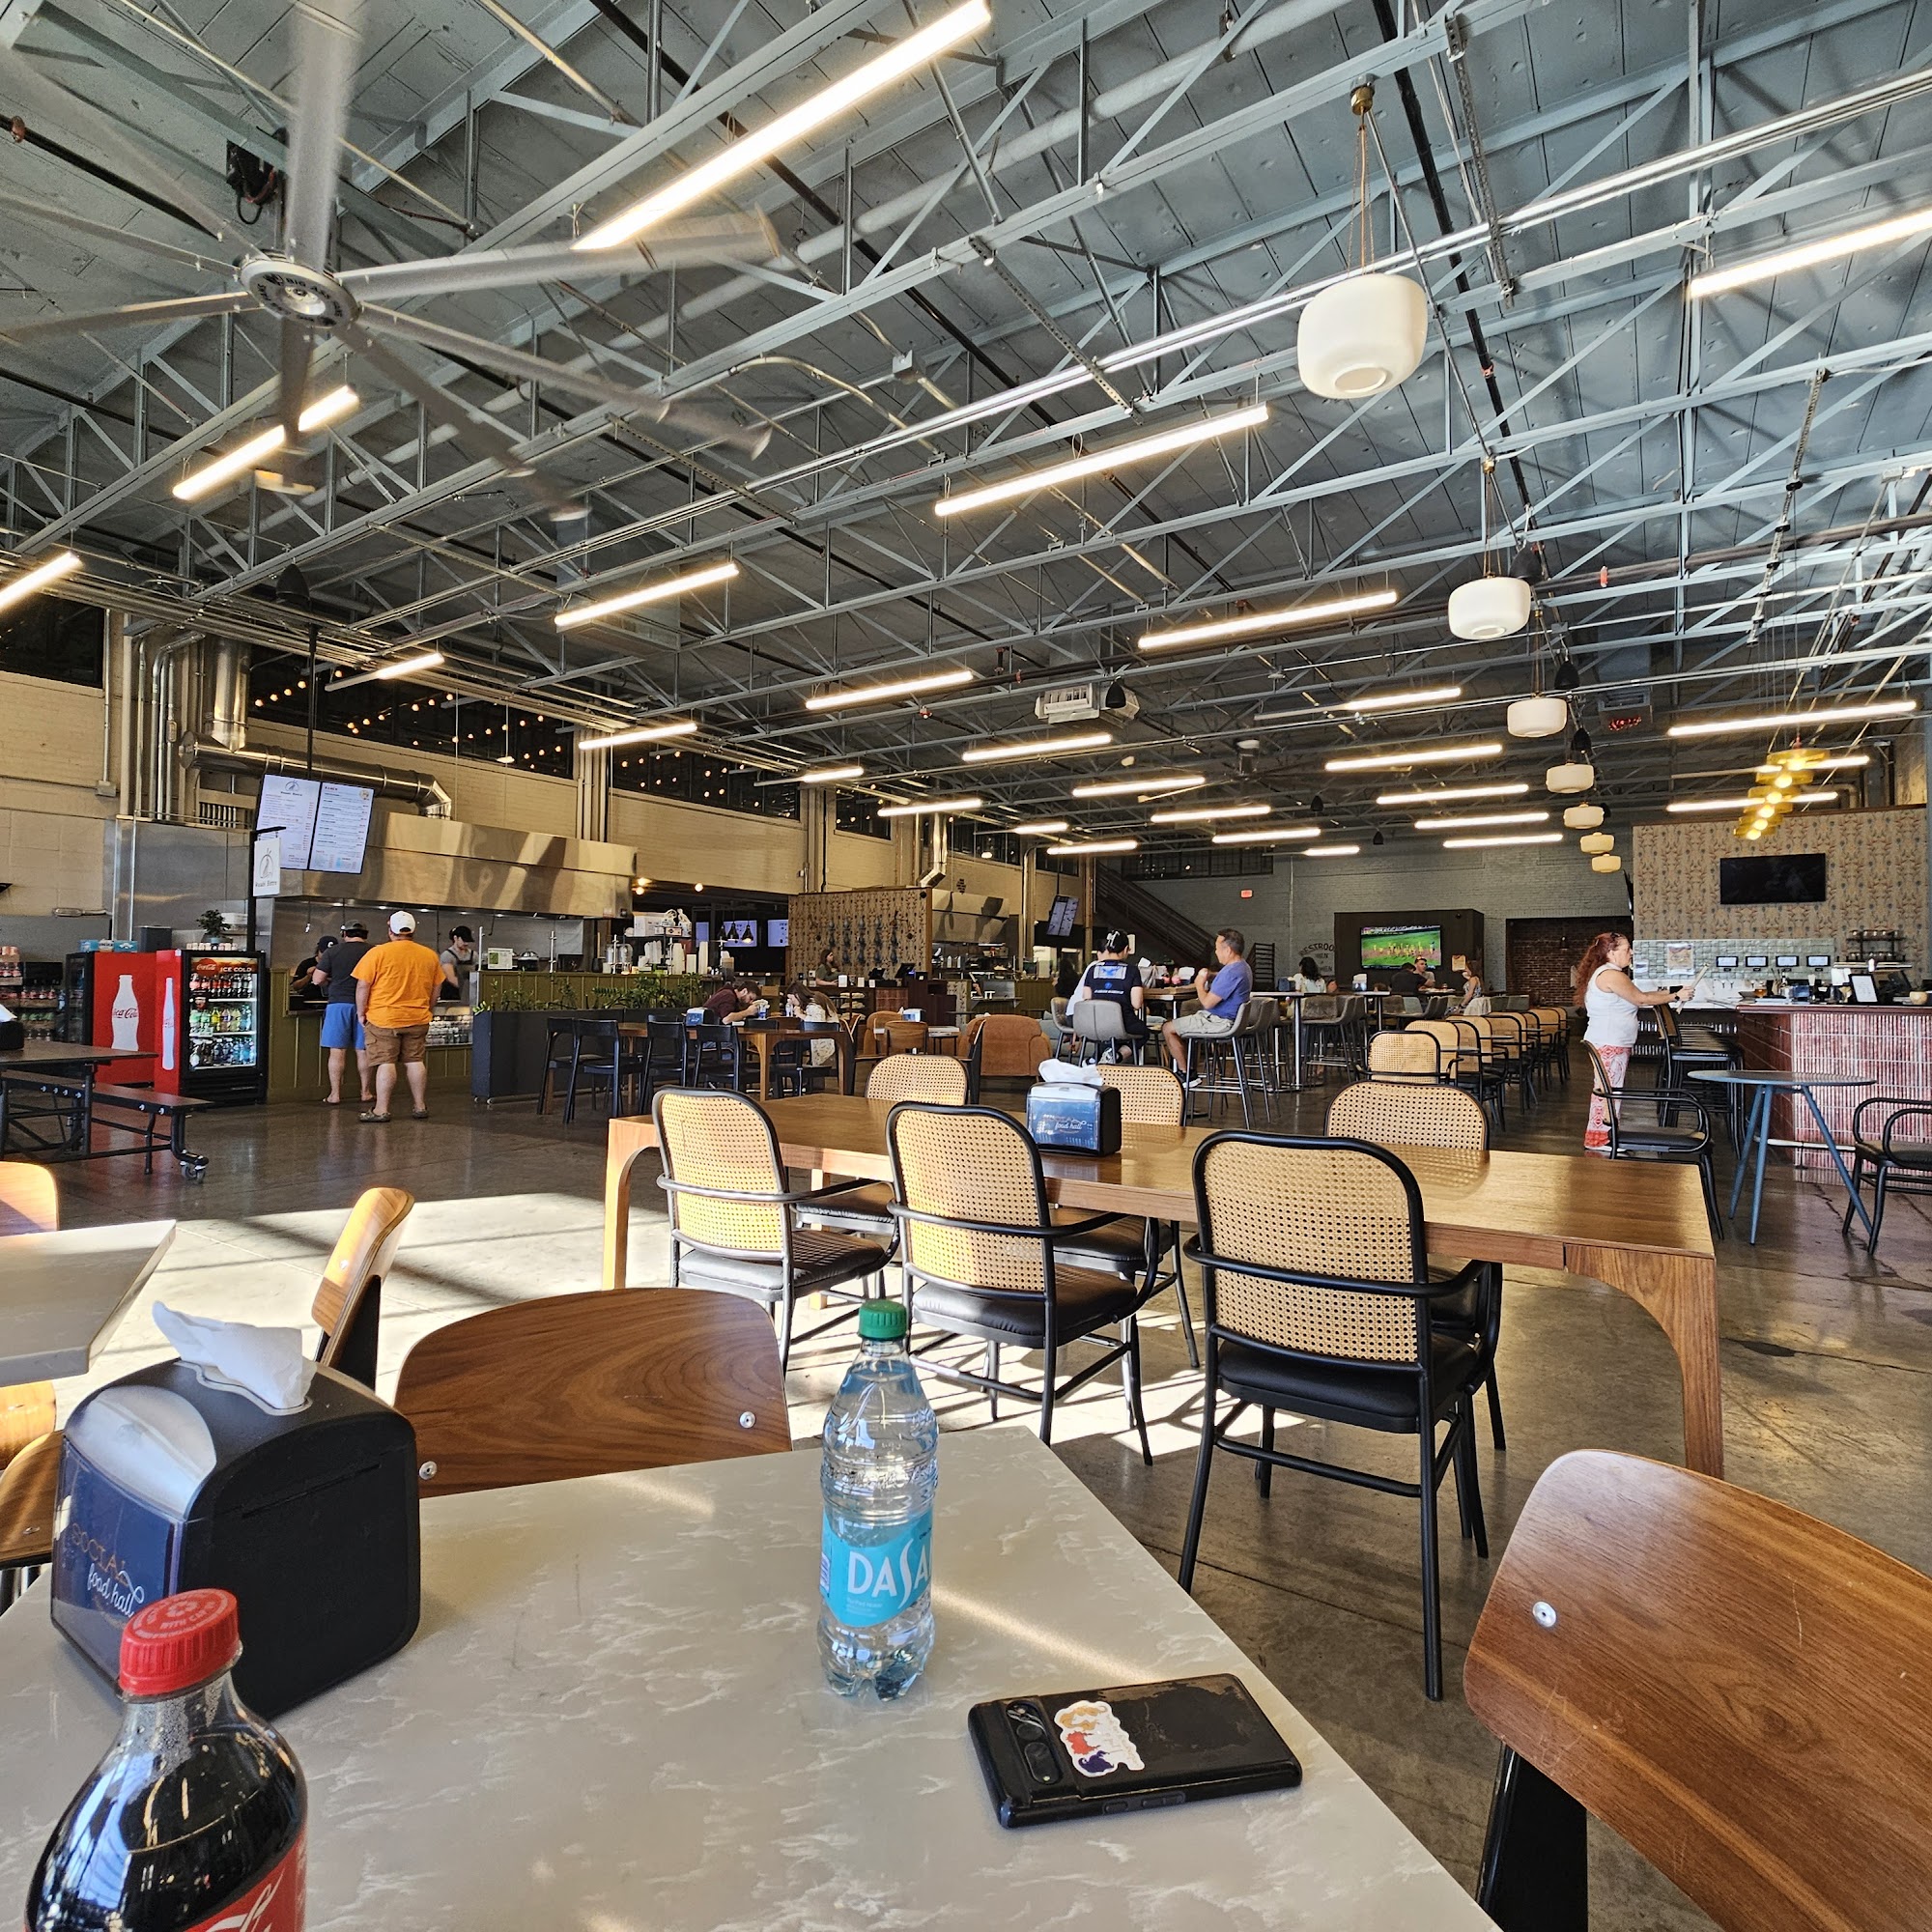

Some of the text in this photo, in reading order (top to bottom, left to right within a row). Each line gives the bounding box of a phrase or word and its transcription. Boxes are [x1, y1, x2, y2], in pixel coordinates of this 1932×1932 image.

[286, 277, 306, 287] BIG
[1298, 943, 1335, 957] RESTROO
[1055, 1120, 1085, 1130] food hall
[72, 1522, 129, 1587] SOCIAL
[87, 1563, 110, 1600] food
[111, 1574, 143, 1618] hall
[847, 1538, 933, 1610] DASA
